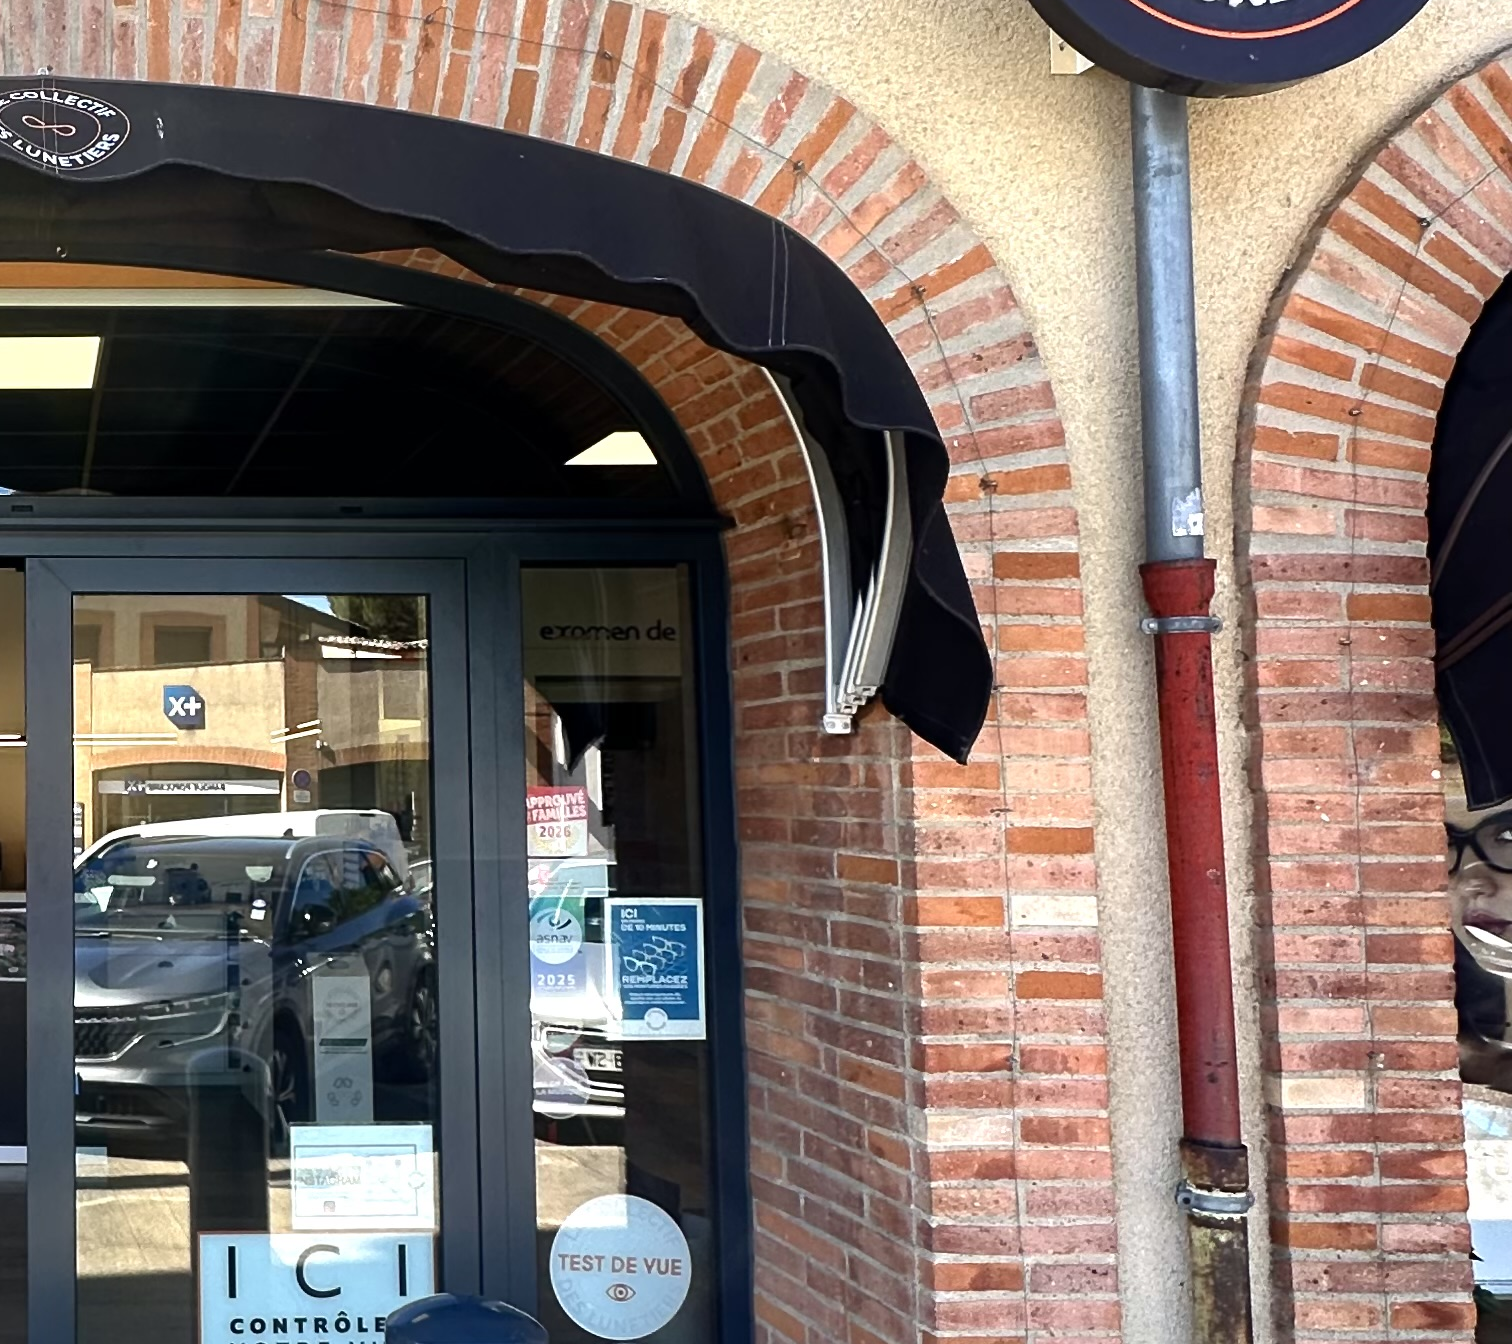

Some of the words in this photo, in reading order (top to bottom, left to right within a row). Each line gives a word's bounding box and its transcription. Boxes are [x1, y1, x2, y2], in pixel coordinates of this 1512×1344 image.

[9, 90, 117, 119] COLLECTIF
[12, 132, 121, 168] LUNETIERS
[646, 618, 676, 641] de
[539, 825, 572, 838] 2026
[620, 908, 638, 919] ICI
[646, 923, 687, 932] MINUTES
[537, 974, 576, 986] 2025
[622, 975, 688, 984] REMPLACEZ
[227, 1243, 407, 1300] ICI
[558, 1253, 606, 1273] TEST
[611, 1255, 638, 1275] DE
[643, 1256, 682, 1276] VUE
[229, 1310, 386, 1335] CONTRÔLE
